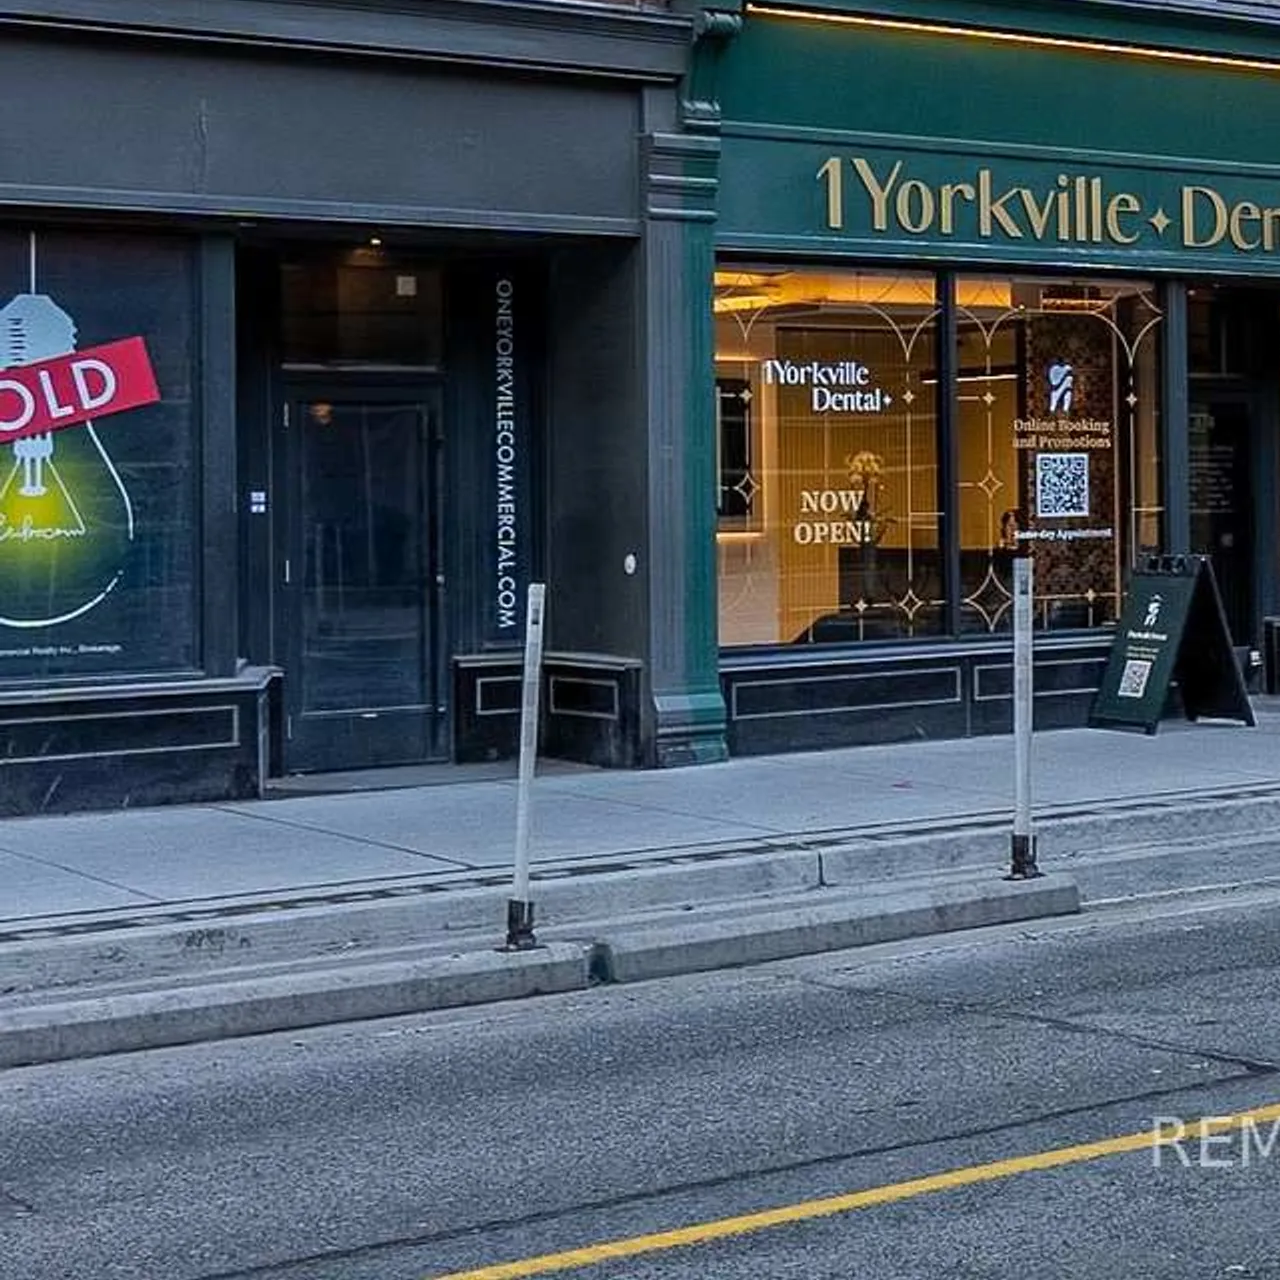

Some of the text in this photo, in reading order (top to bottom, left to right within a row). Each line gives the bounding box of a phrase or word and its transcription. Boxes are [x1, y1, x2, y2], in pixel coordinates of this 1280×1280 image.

[816, 157, 1141, 244] 1Yorkville
[812, 387, 882, 411] Dental
[1058, 419, 1110, 435] Booking
[496, 278, 516, 628] ONEYORKVILLECOMMERCIAL.COM
[1039, 434, 1111, 449] Promotions
[801, 490, 865, 513] NOW
[794, 521, 872, 544] OPEN!
